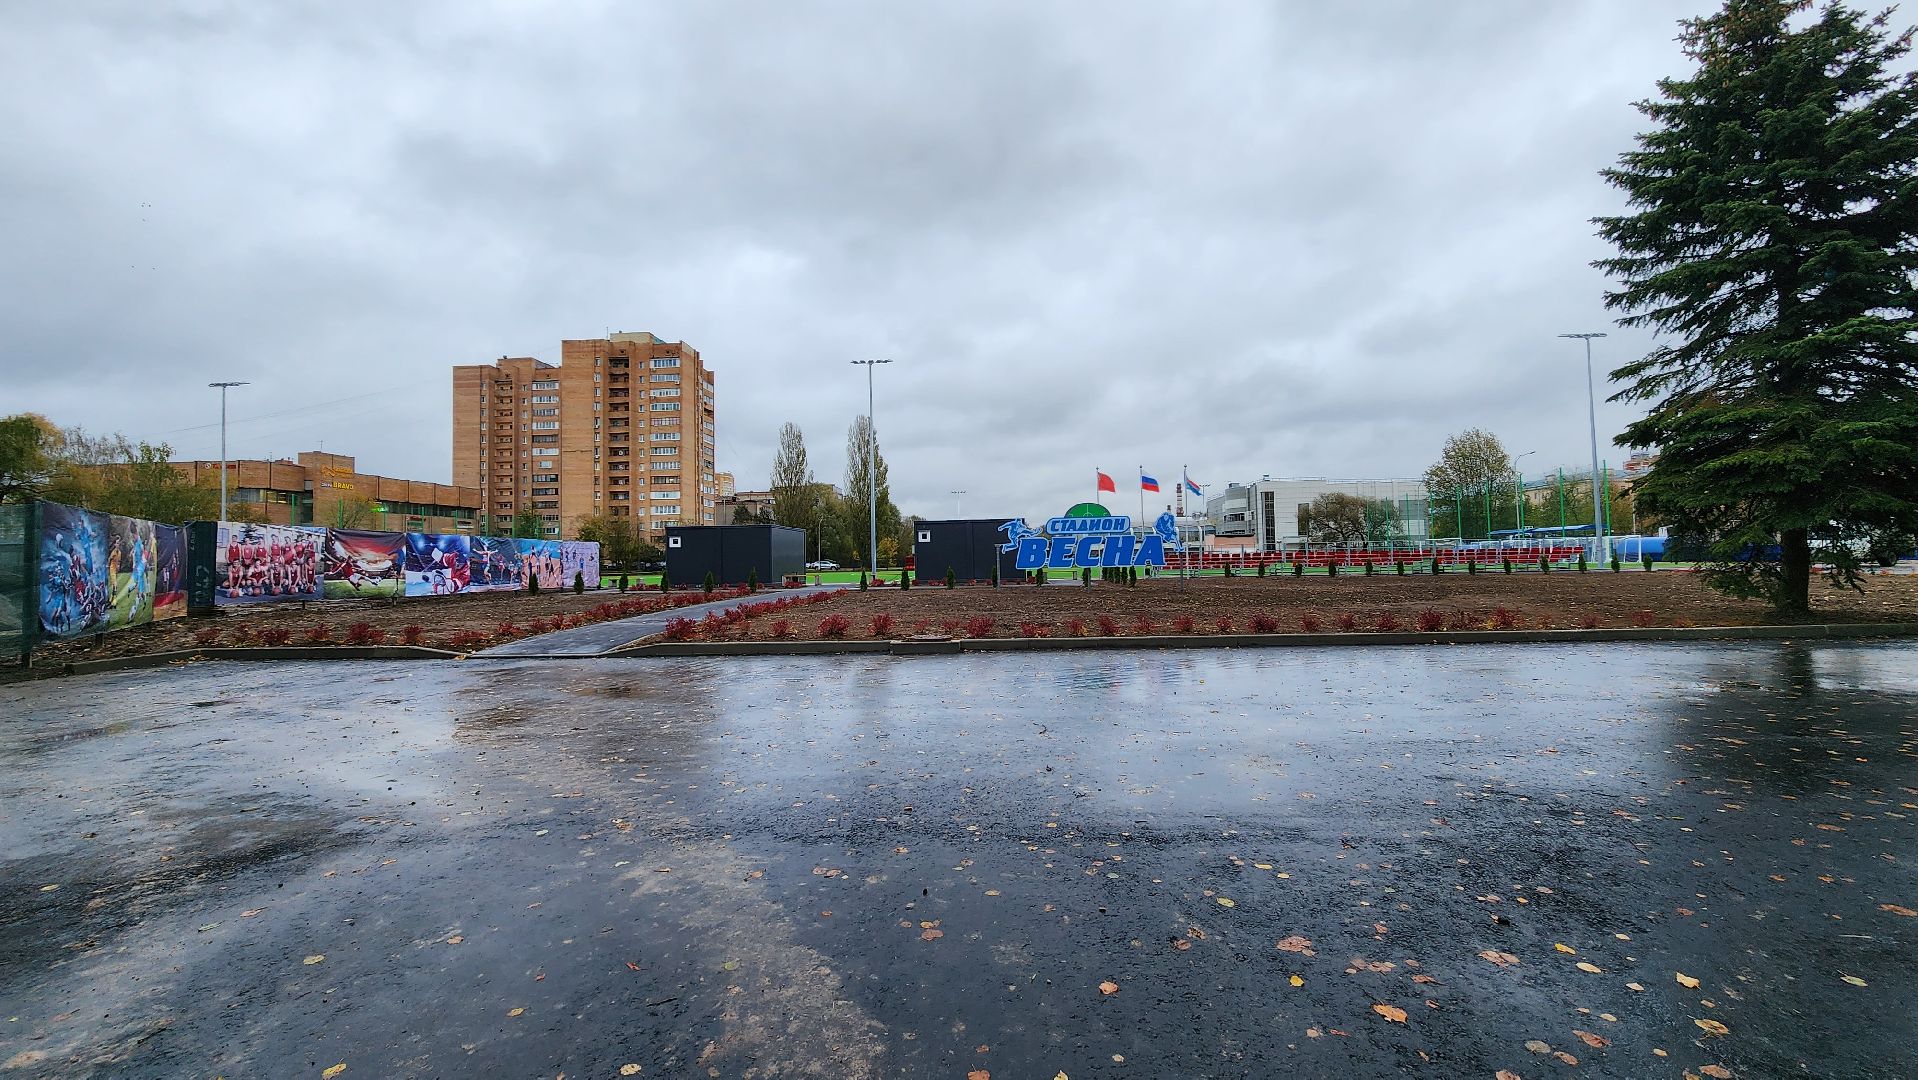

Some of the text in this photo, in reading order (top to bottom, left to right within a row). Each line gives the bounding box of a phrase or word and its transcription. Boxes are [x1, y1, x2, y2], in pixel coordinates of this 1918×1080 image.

[333, 481, 354, 490] BRAVO
[1050, 518, 1126, 532] СТАДИОН
[1015, 534, 1167, 569] ВЕСНА
